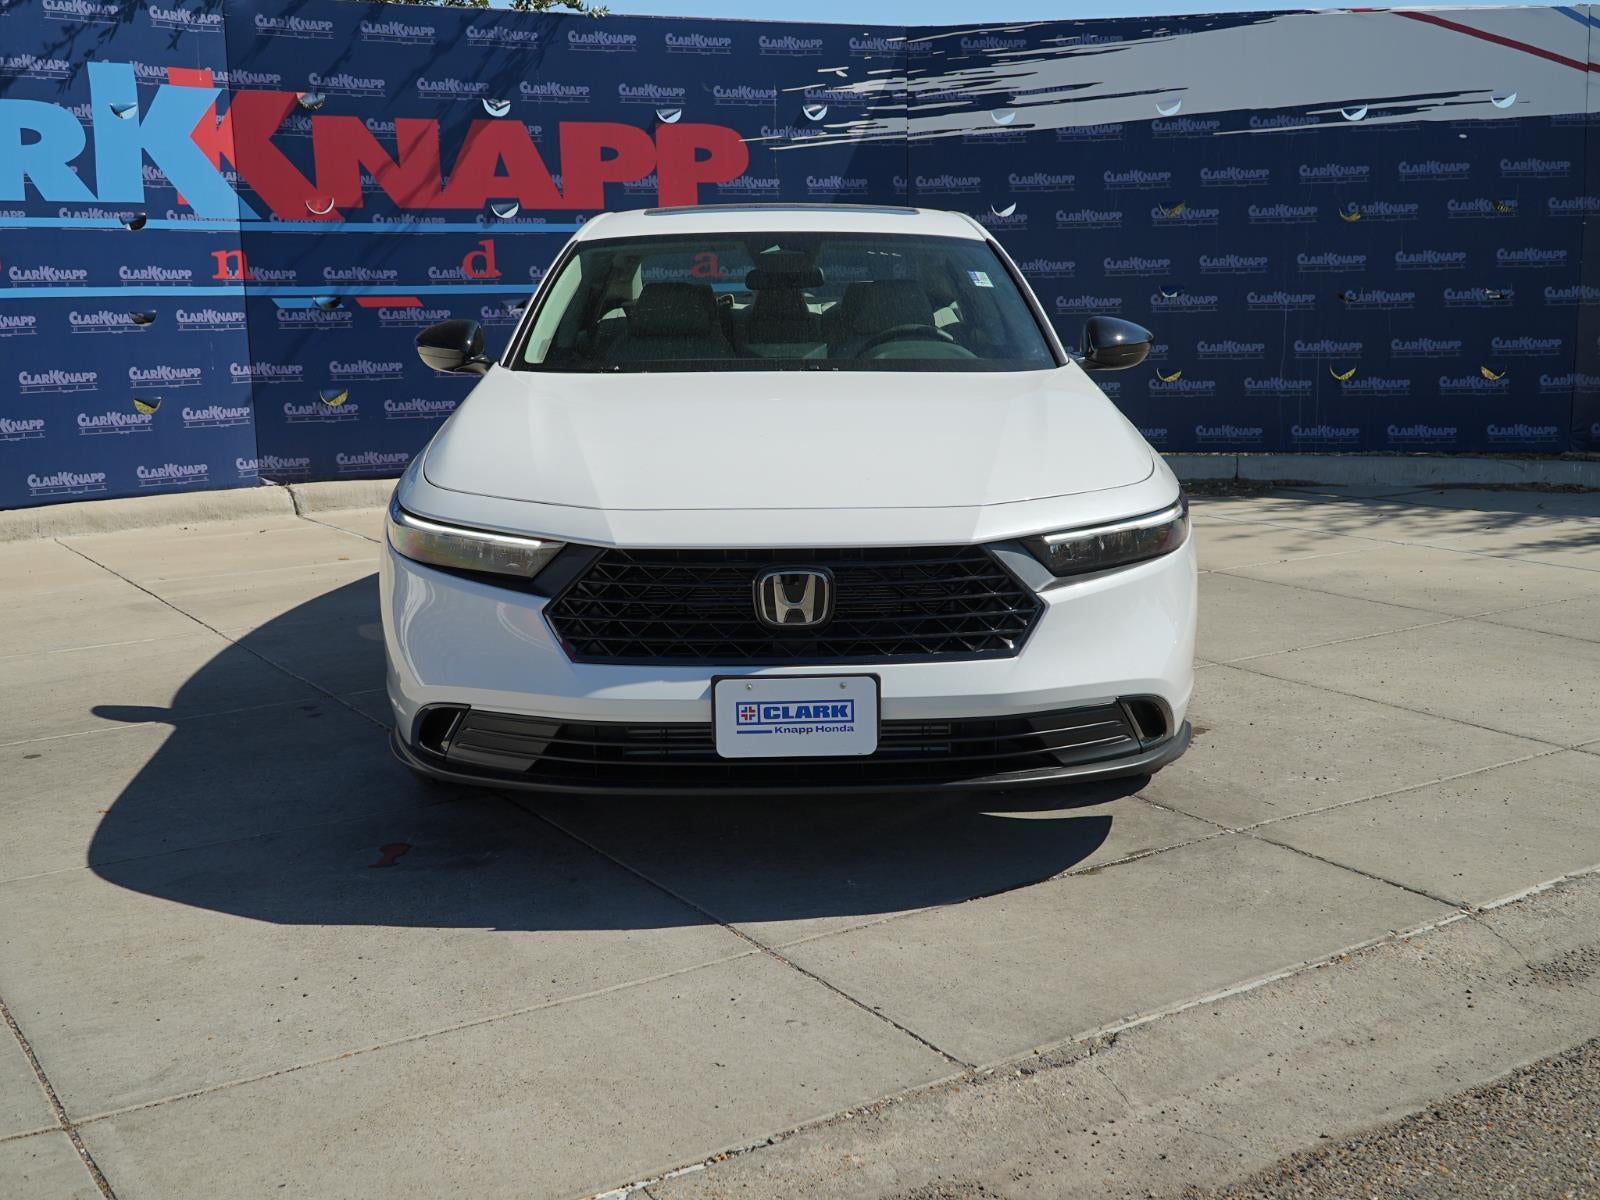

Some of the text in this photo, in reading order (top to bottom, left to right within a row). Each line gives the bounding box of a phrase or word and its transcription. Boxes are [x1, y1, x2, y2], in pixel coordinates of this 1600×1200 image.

[763, 704, 848, 720] CLARK
[774, 724, 854, 735] Knapp Honda
